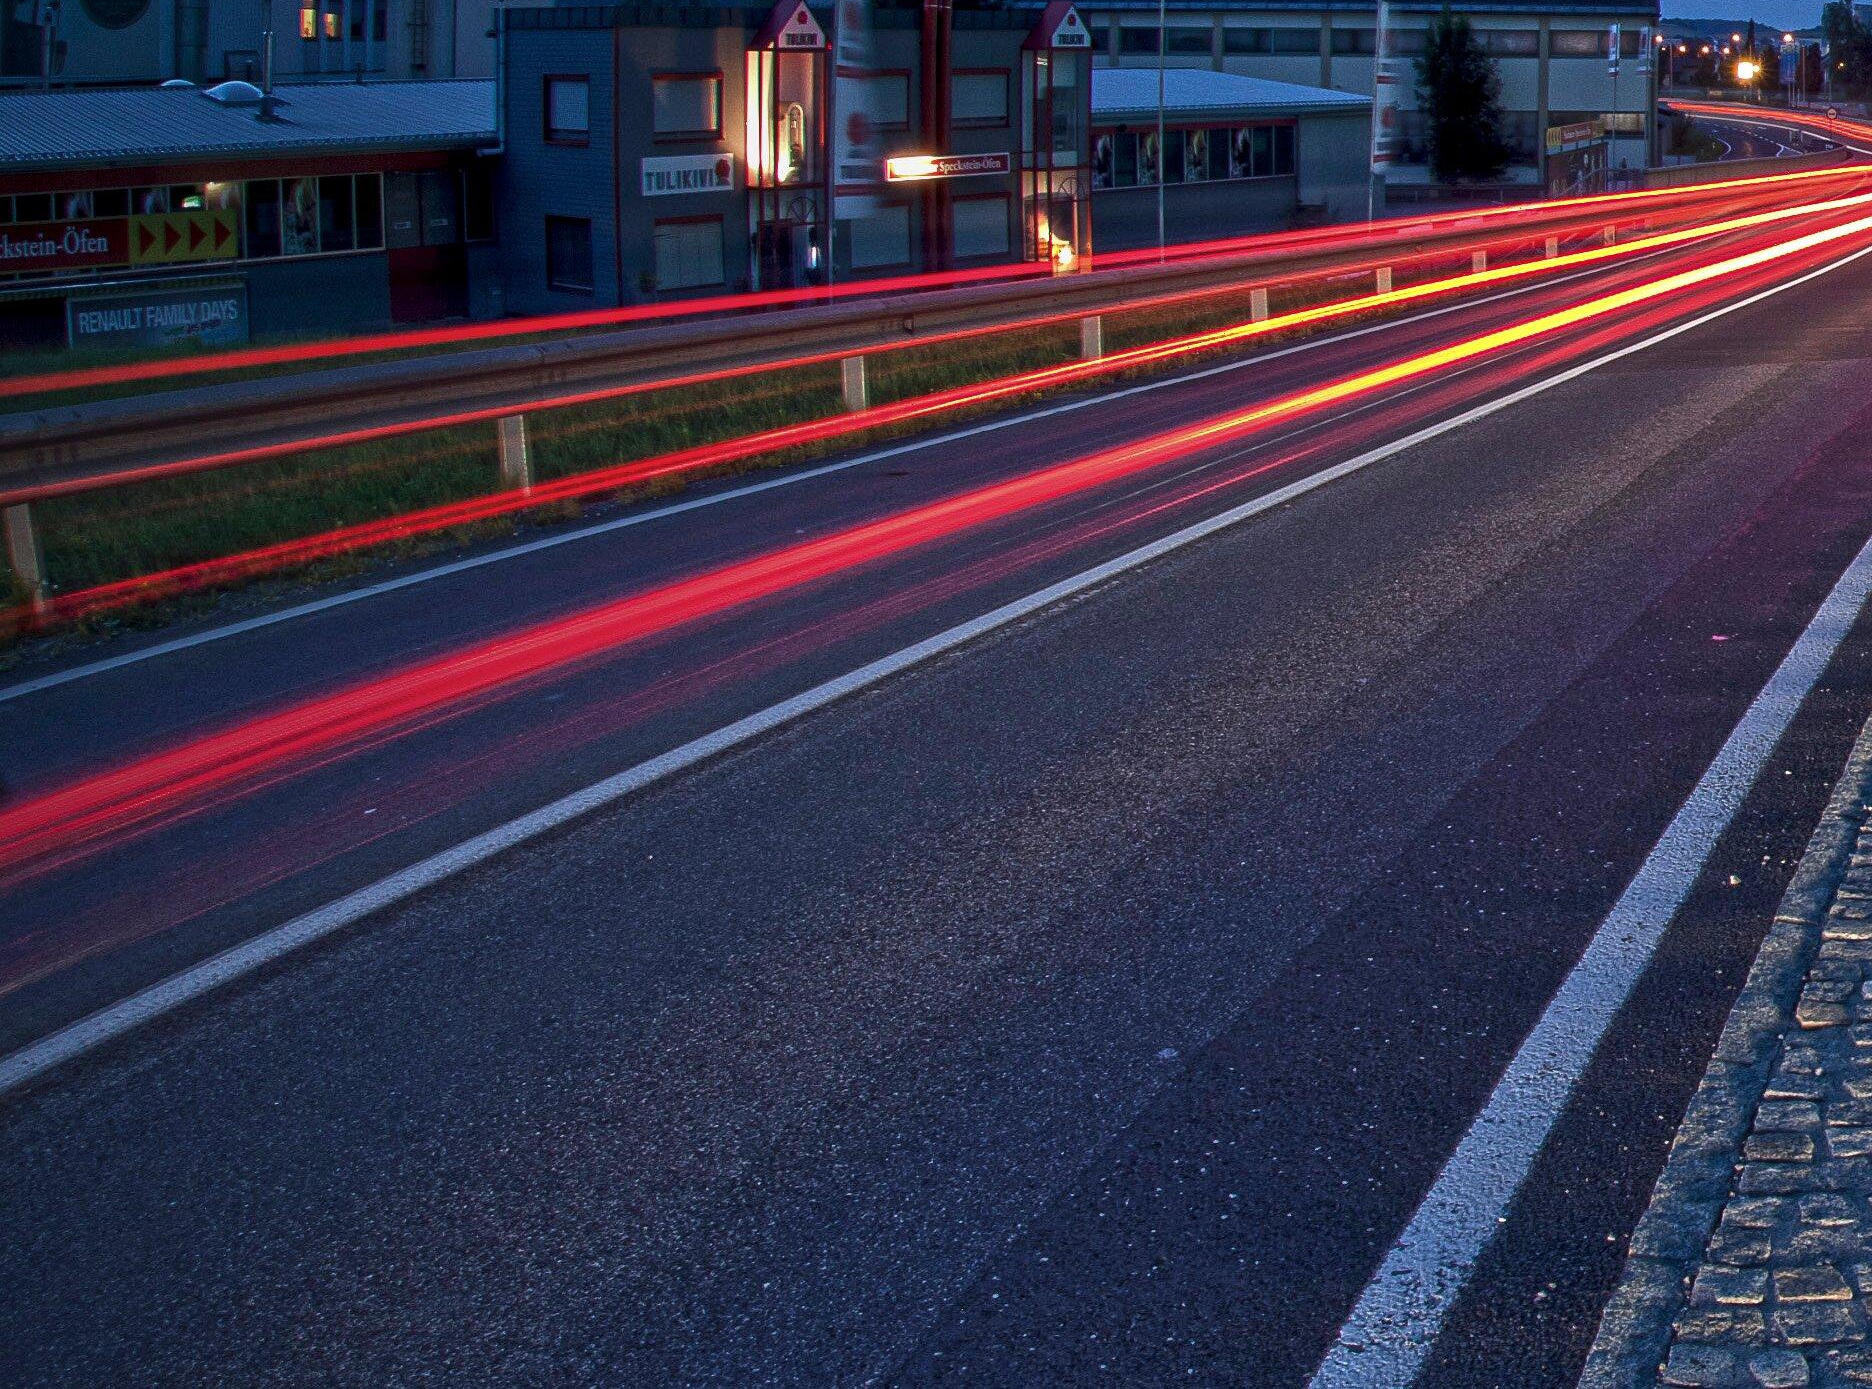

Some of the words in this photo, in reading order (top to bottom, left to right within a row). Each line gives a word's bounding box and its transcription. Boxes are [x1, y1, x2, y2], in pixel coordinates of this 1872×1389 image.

[644, 168, 714, 191] TULIKIVI
[78, 308, 142, 335] RENAULT
[146, 303, 198, 328] FAMILY
[200, 299, 238, 321] DAYS
